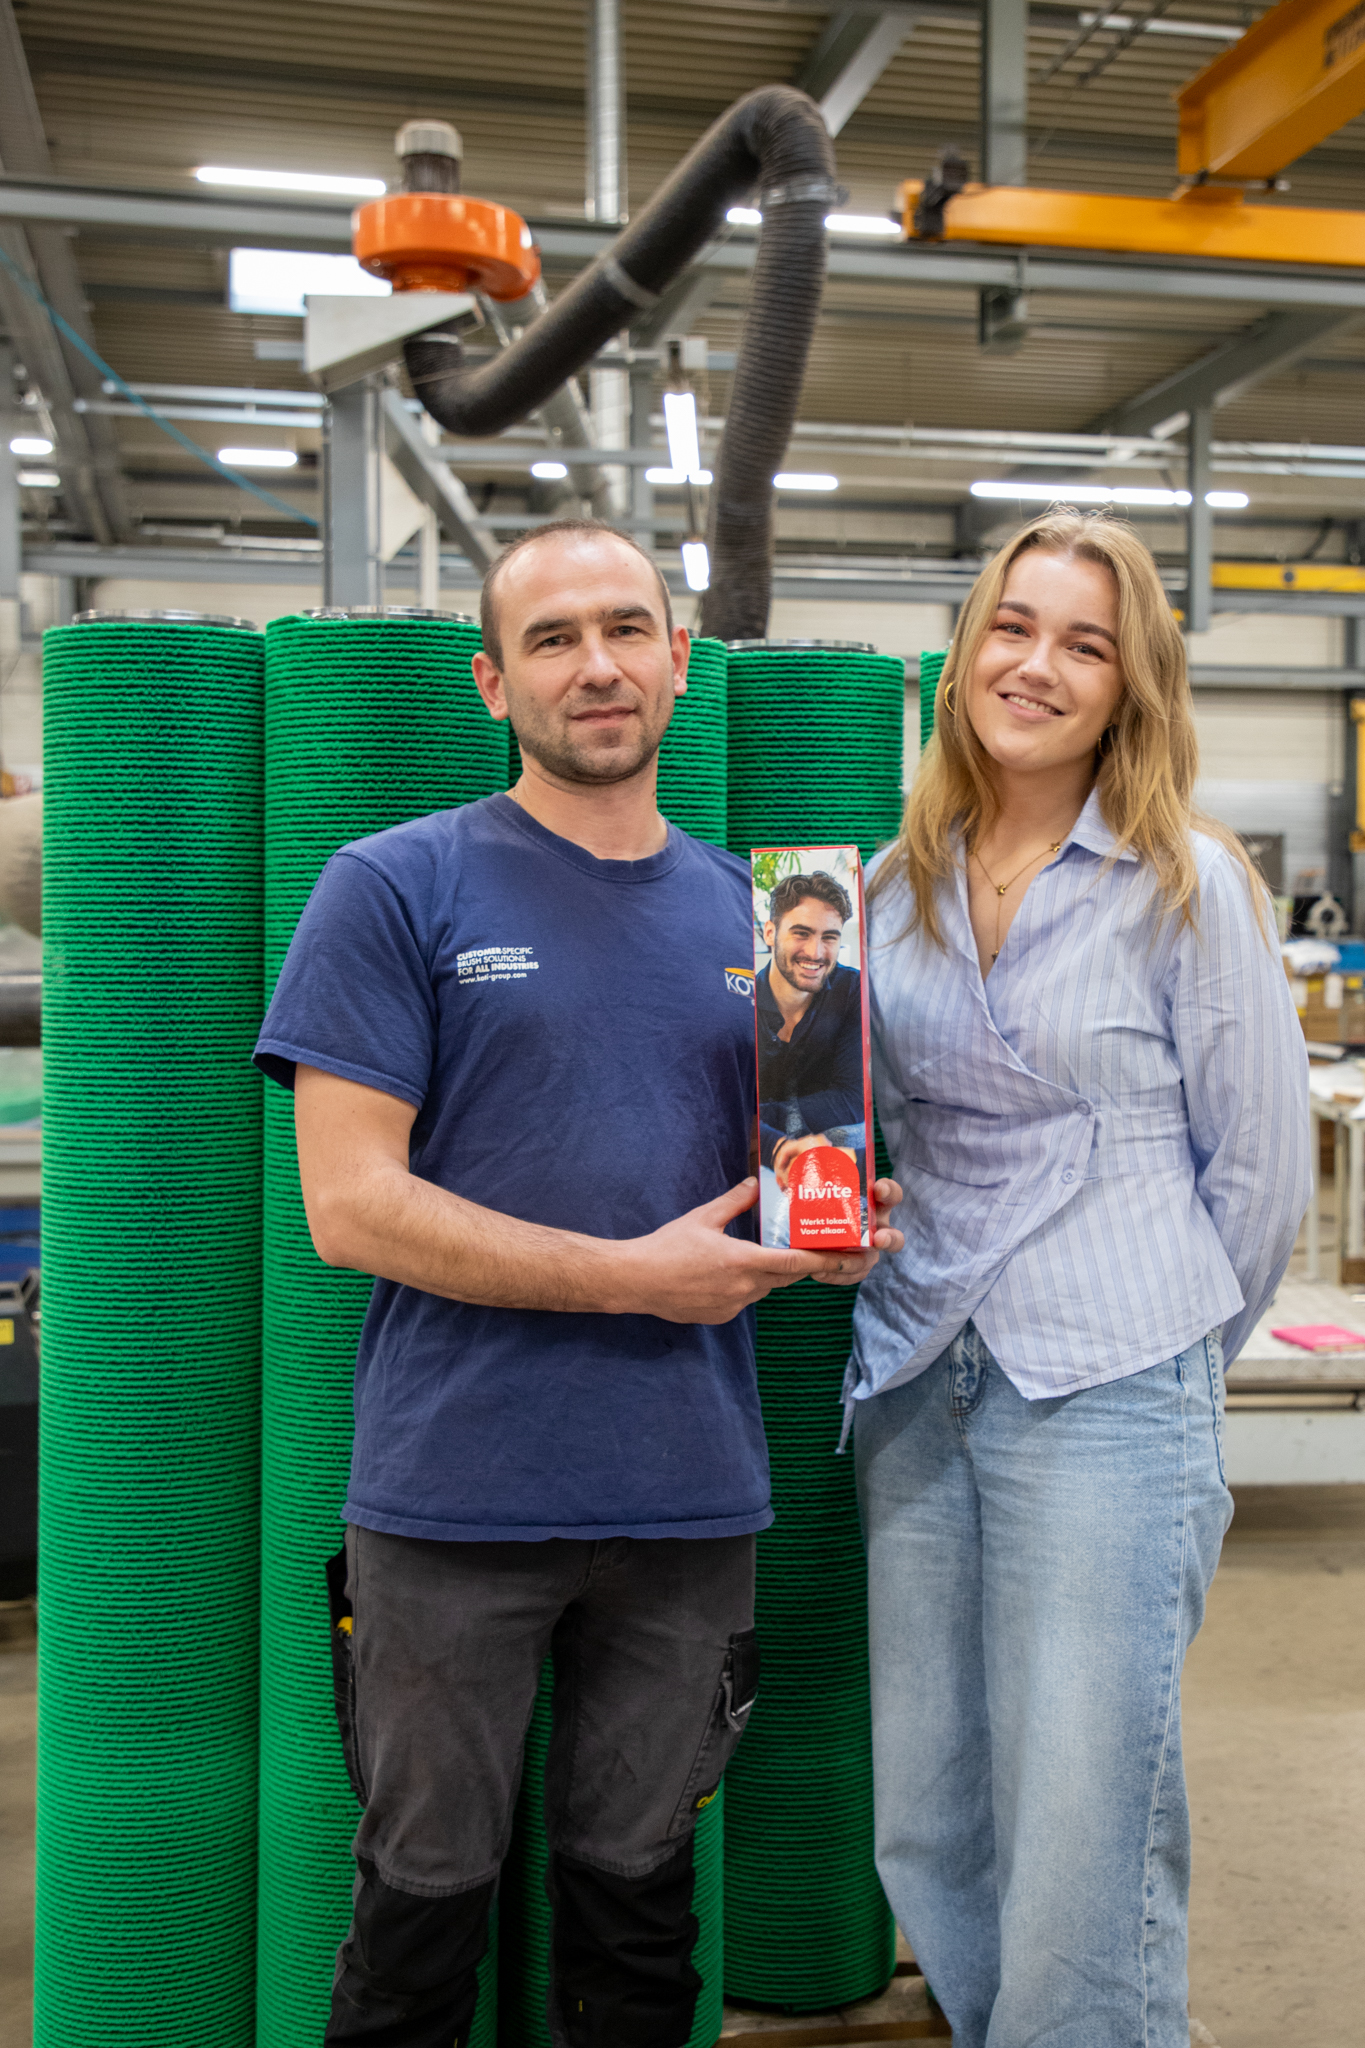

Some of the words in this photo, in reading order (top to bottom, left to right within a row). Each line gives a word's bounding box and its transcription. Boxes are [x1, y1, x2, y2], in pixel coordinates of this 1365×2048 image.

[457, 957, 481, 968] BRUSH
[483, 955, 526, 963] SOLUTIONS
[458, 967, 473, 976] FOR
[475, 964, 490, 973] ALL
[491, 962, 539, 971] INDUSTRIES
[798, 1181, 852, 1200] Invite
[800, 1218, 825, 1226] Werkt
[826, 1217, 853, 1225] lokaal.
[820, 1227, 847, 1235] elkaar.
